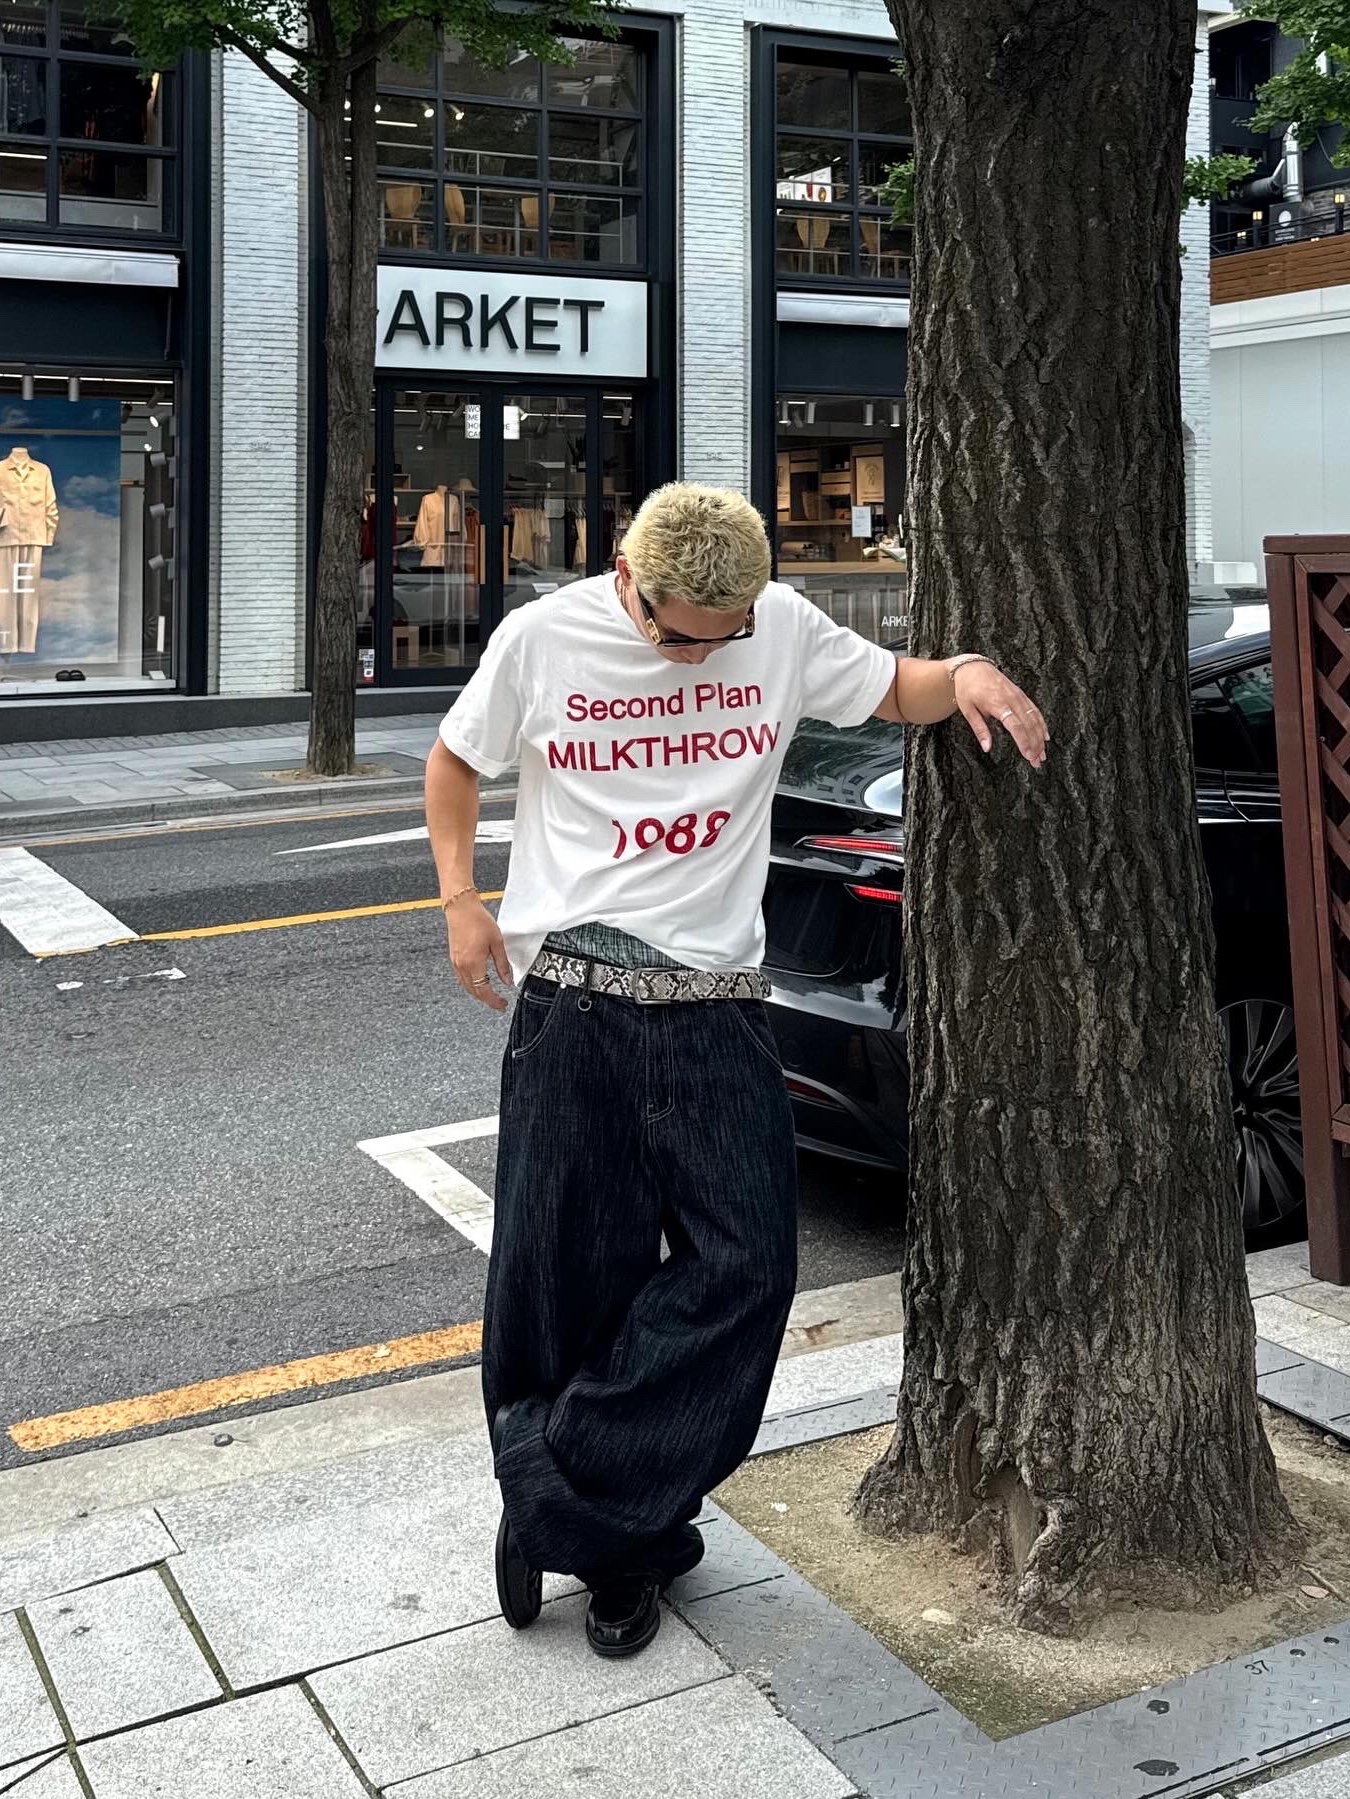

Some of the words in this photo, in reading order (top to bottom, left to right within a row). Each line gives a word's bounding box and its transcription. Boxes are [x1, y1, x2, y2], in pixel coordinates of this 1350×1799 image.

[383, 289, 605, 354] ARKET
[881, 616, 908, 627] ARKE
[566, 687, 684, 722] Second
[695, 682, 762, 712] Plan
[548, 721, 781, 772] MILKTHROW
[1244, 1660, 1270, 1675] 37
